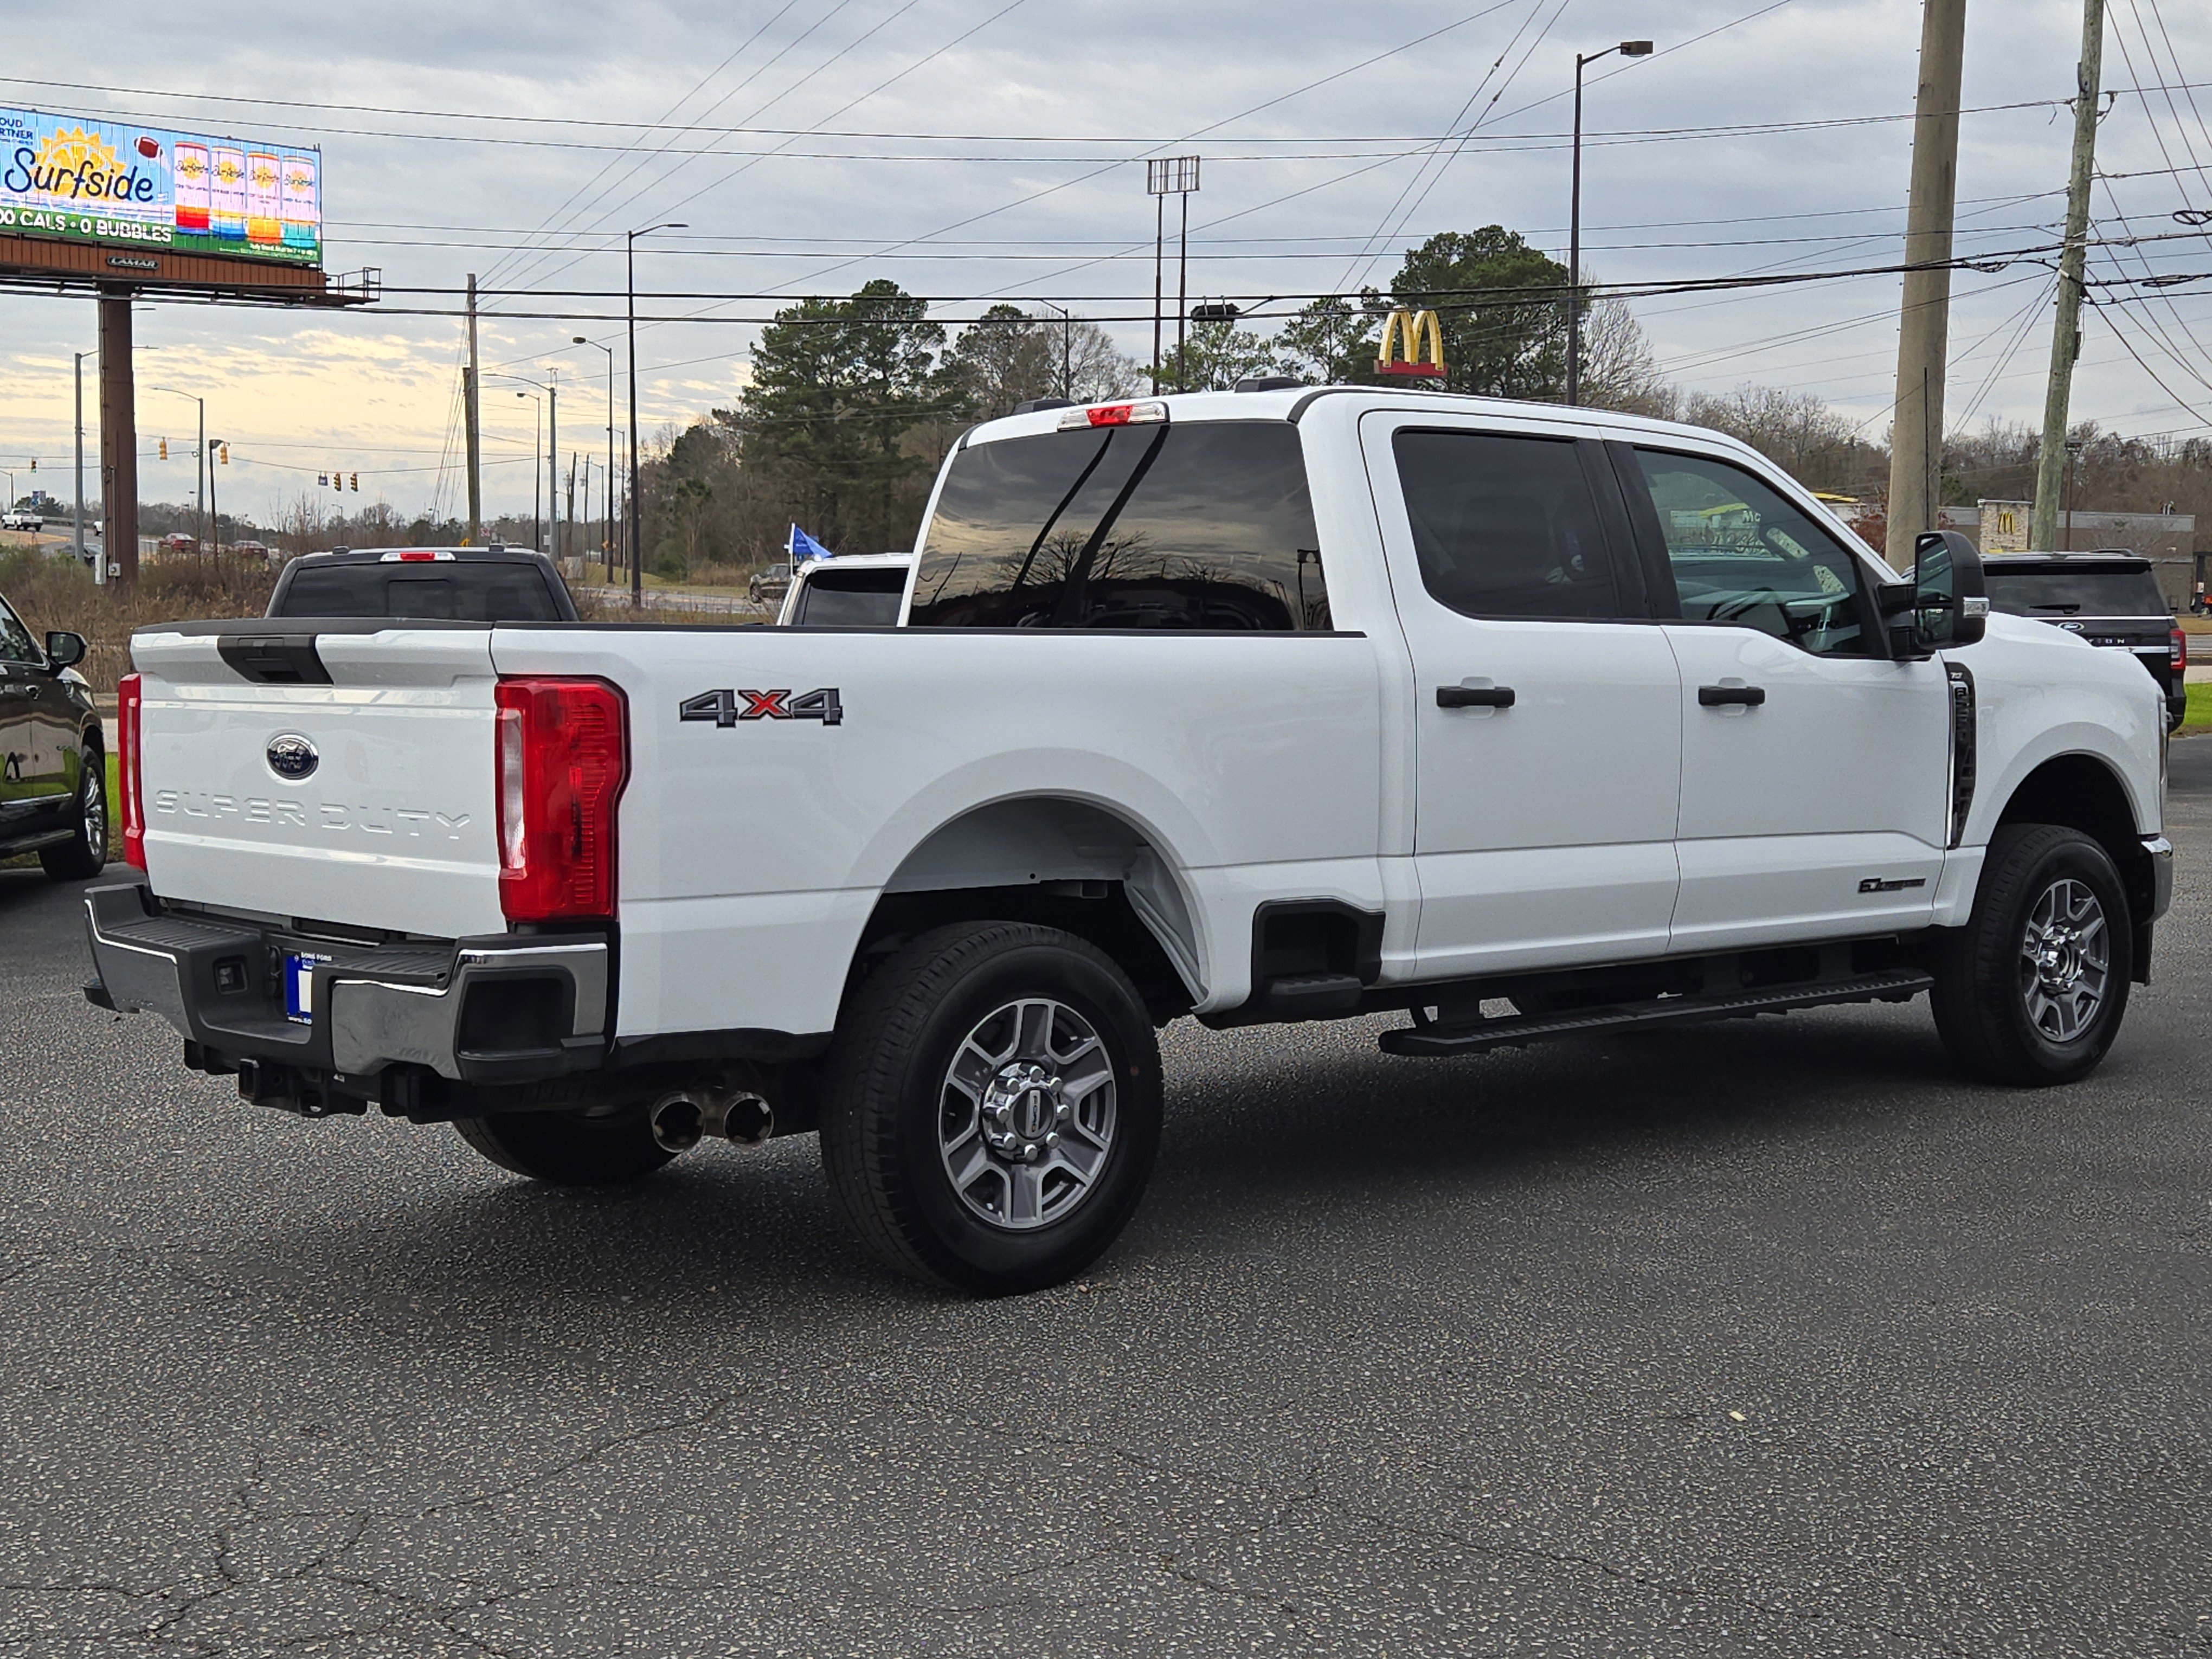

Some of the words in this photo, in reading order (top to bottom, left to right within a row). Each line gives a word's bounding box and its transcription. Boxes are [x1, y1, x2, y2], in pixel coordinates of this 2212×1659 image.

[5, 147, 153, 202] Surfside
[20, 210, 66, 232] CALS
[96, 221, 171, 242] BUBBLES
[111, 258, 155, 268] LAMAR
[680, 687, 843, 728] 4X4
[156, 789, 306, 826] SUPER
[320, 802, 470, 840] DUTY
